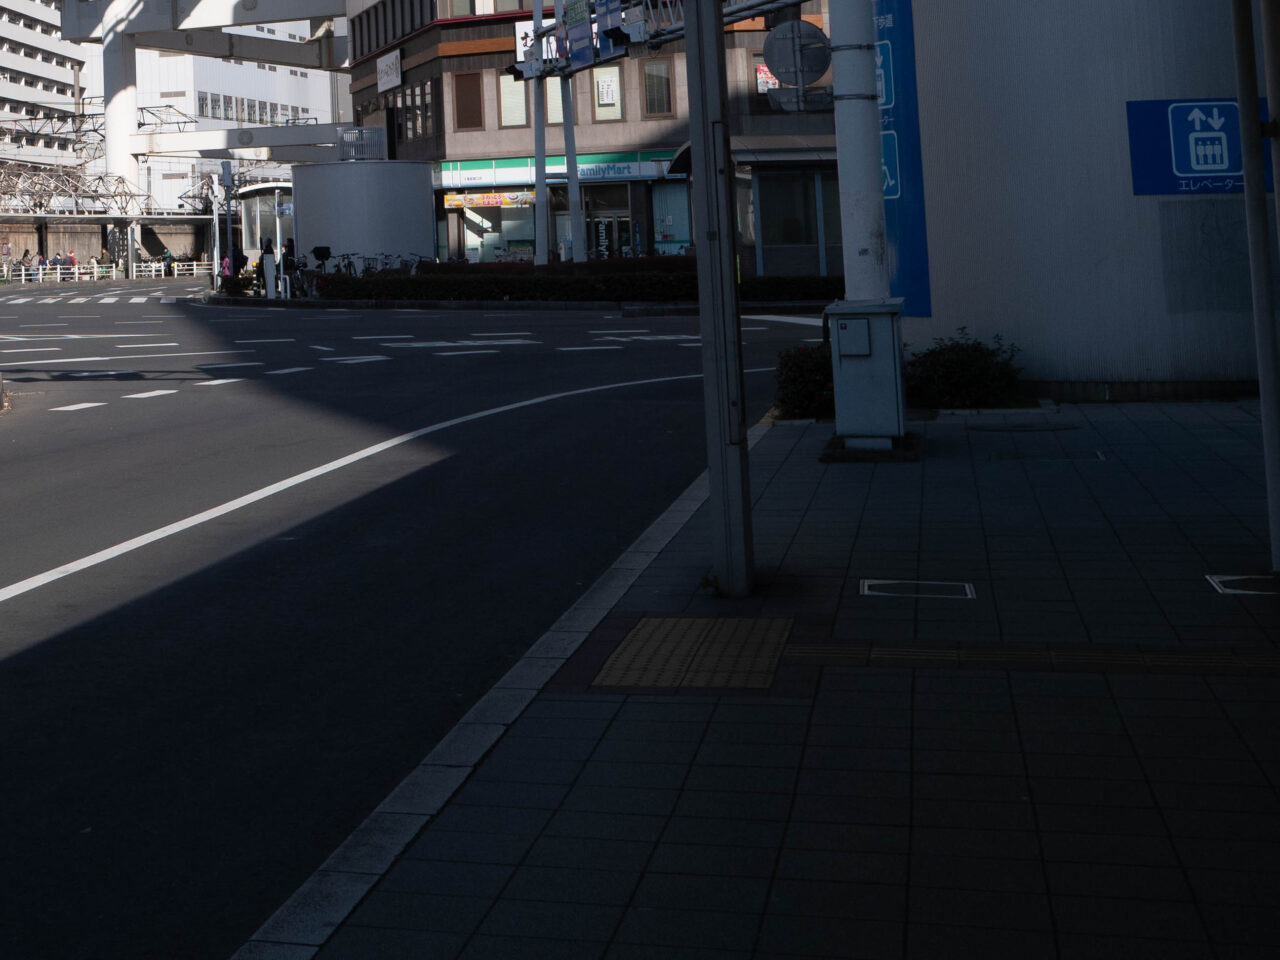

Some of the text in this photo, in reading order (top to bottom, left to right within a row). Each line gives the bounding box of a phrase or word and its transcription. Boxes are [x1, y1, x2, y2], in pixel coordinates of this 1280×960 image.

[1179, 179, 1246, 190] エレベーター
